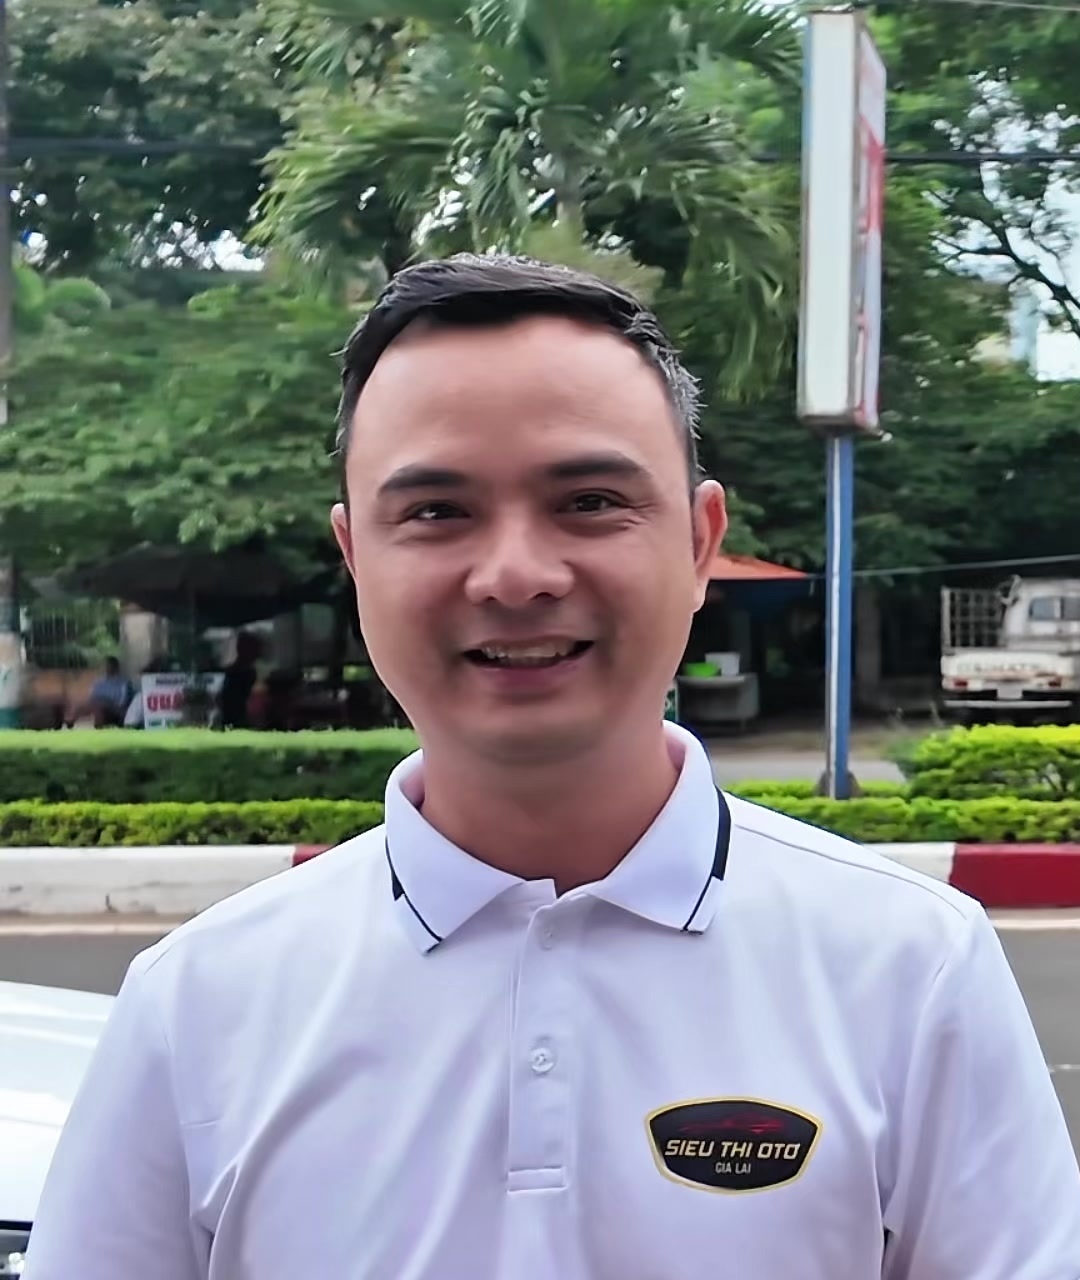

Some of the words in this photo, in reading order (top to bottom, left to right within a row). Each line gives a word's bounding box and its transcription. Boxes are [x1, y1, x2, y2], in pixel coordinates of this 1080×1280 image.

[664, 1139, 715, 1157] SIEU
[721, 1141, 753, 1158] THI
[715, 1162, 732, 1174] GIA
[735, 1162, 752, 1175] LAI
